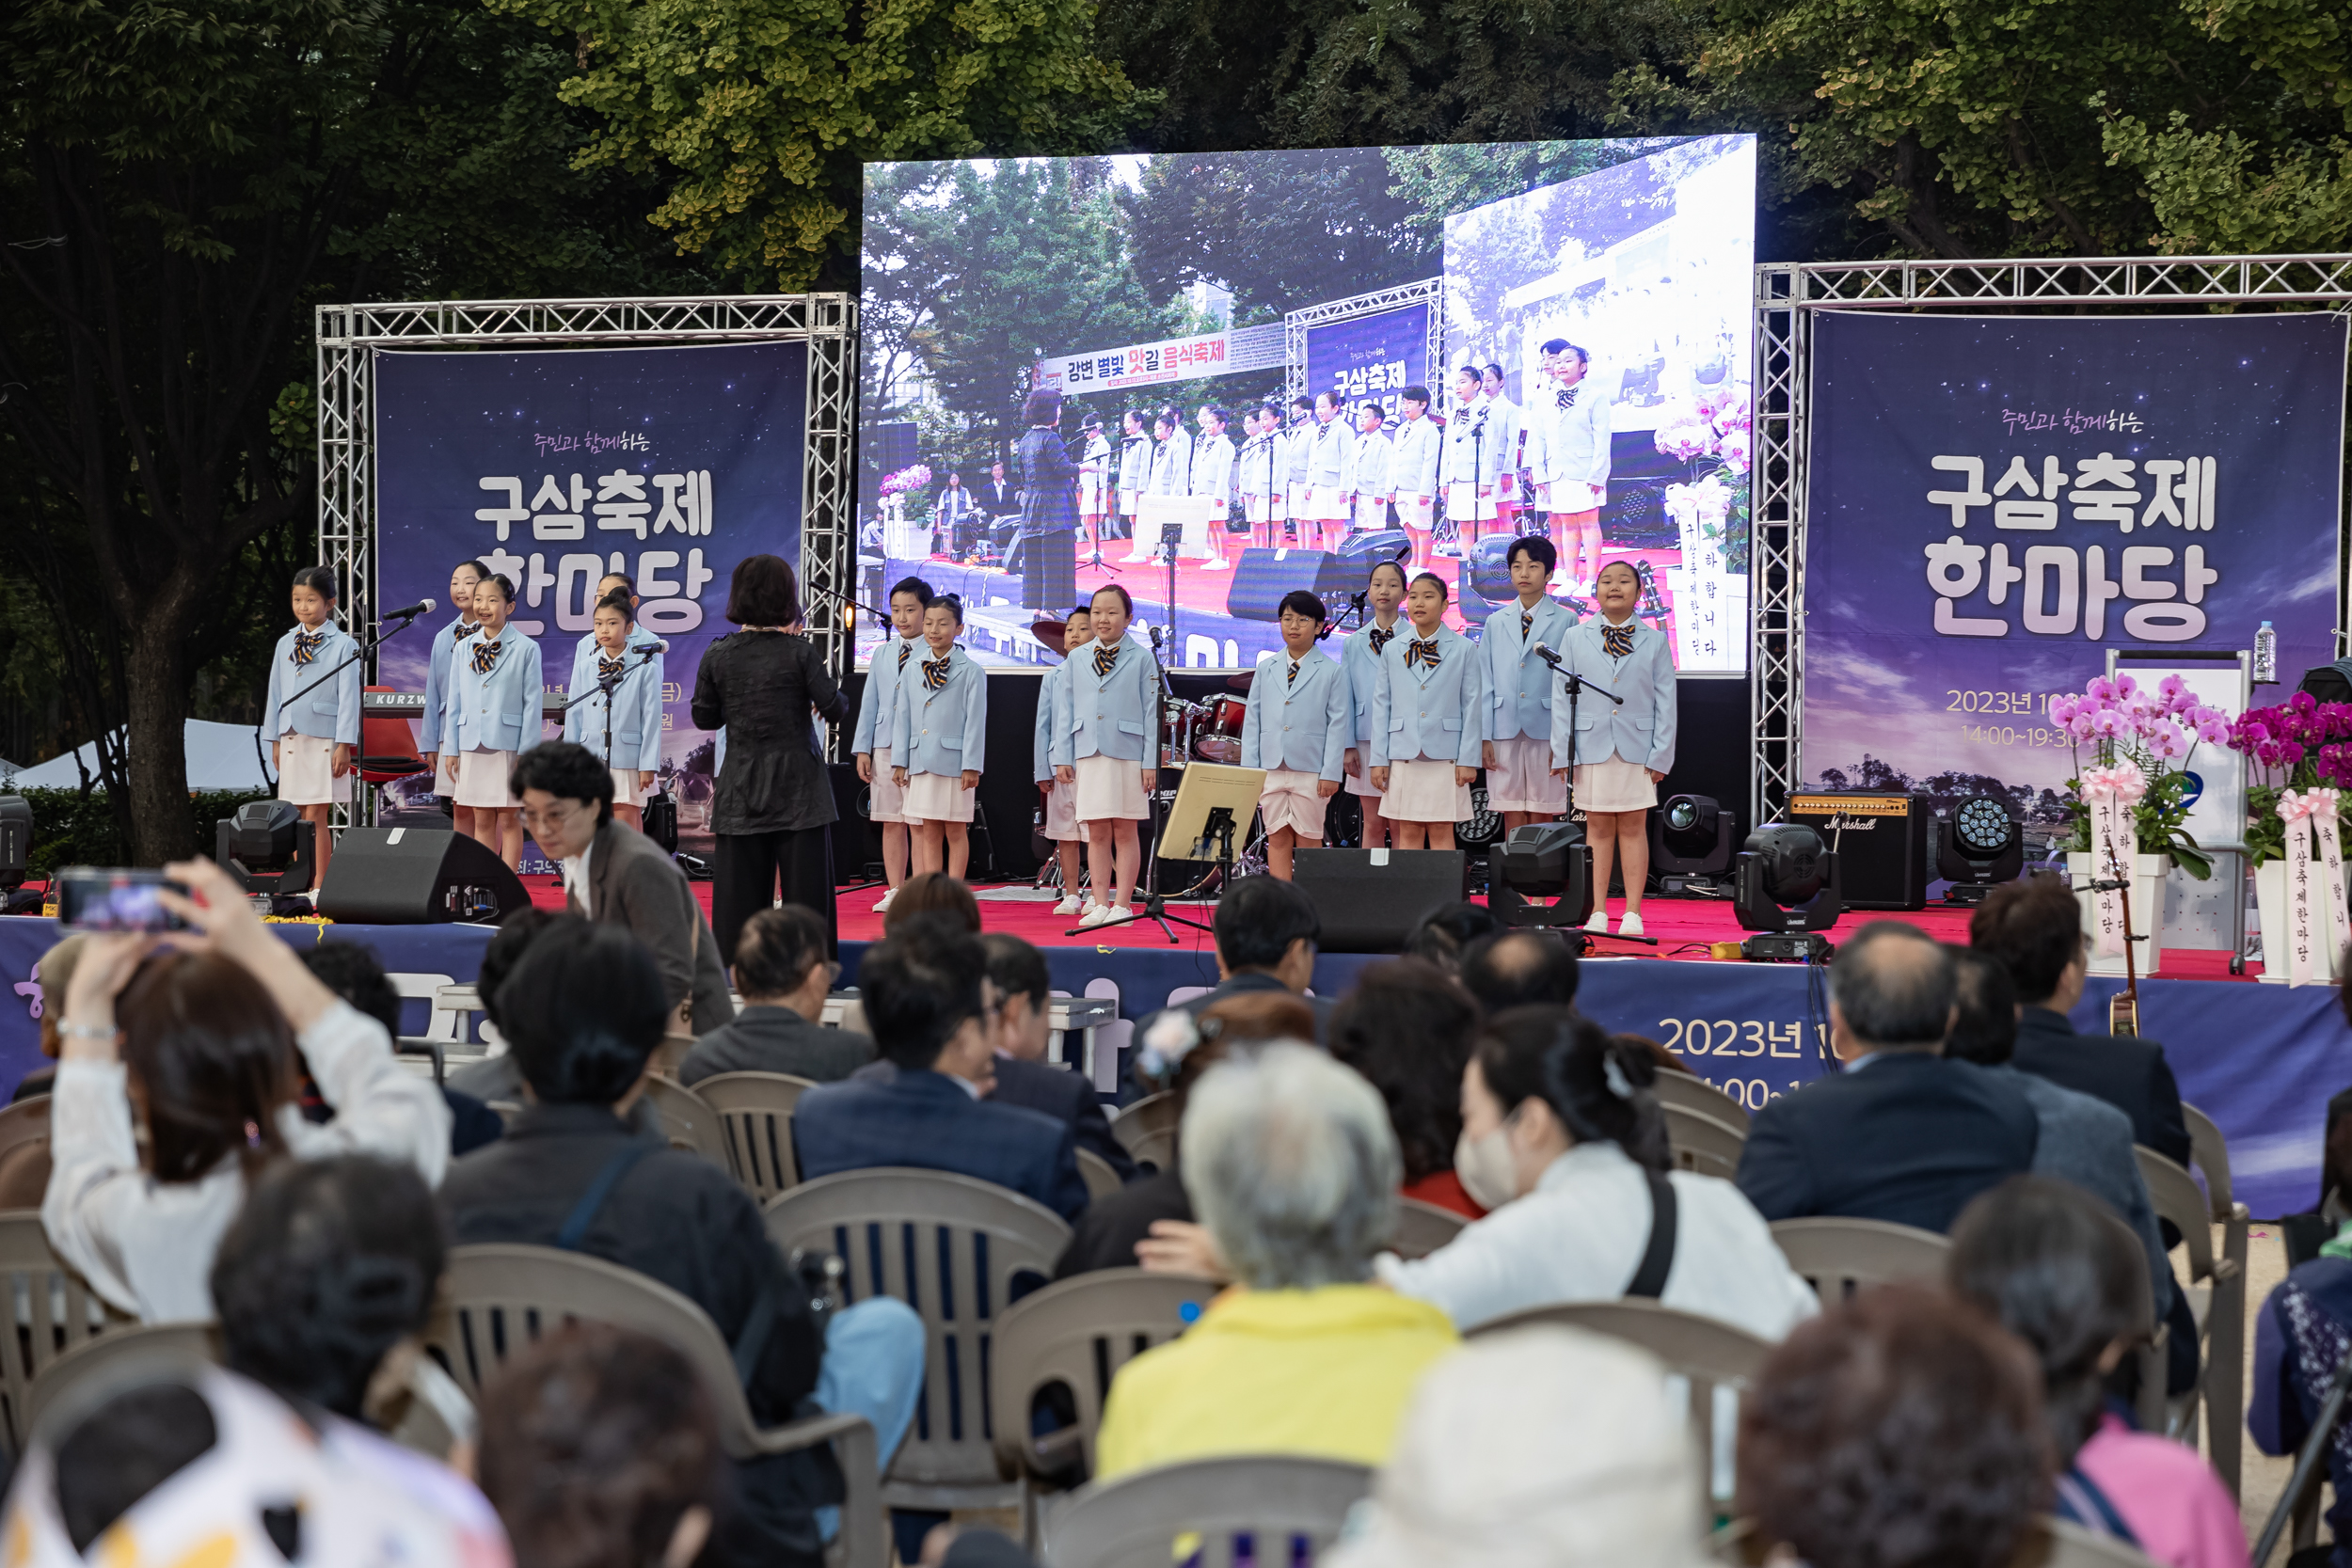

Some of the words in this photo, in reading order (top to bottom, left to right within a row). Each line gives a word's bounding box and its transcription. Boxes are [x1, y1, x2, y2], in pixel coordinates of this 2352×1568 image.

[1069, 359, 1093, 382] 강변
[1098, 355, 1124, 378] 별빛
[1129, 348, 1159, 374] 맛길
[1164, 339, 1225, 370] 음식축제
[1334, 359, 1406, 397] 구삼축제
[2002, 408, 2058, 436] 주민과
[2062, 408, 2144, 435] 함께하는
[534, 433, 581, 457] 주민과
[584, 431, 650, 454] 함께하는
[474, 468, 712, 542] 구삼축제
[1927, 451, 2217, 533] 구삼축제
[1924, 535, 2217, 641] 한마당
[1946, 689, 2031, 715] 2023년
[1659, 1018, 1802, 1058] 2023년
